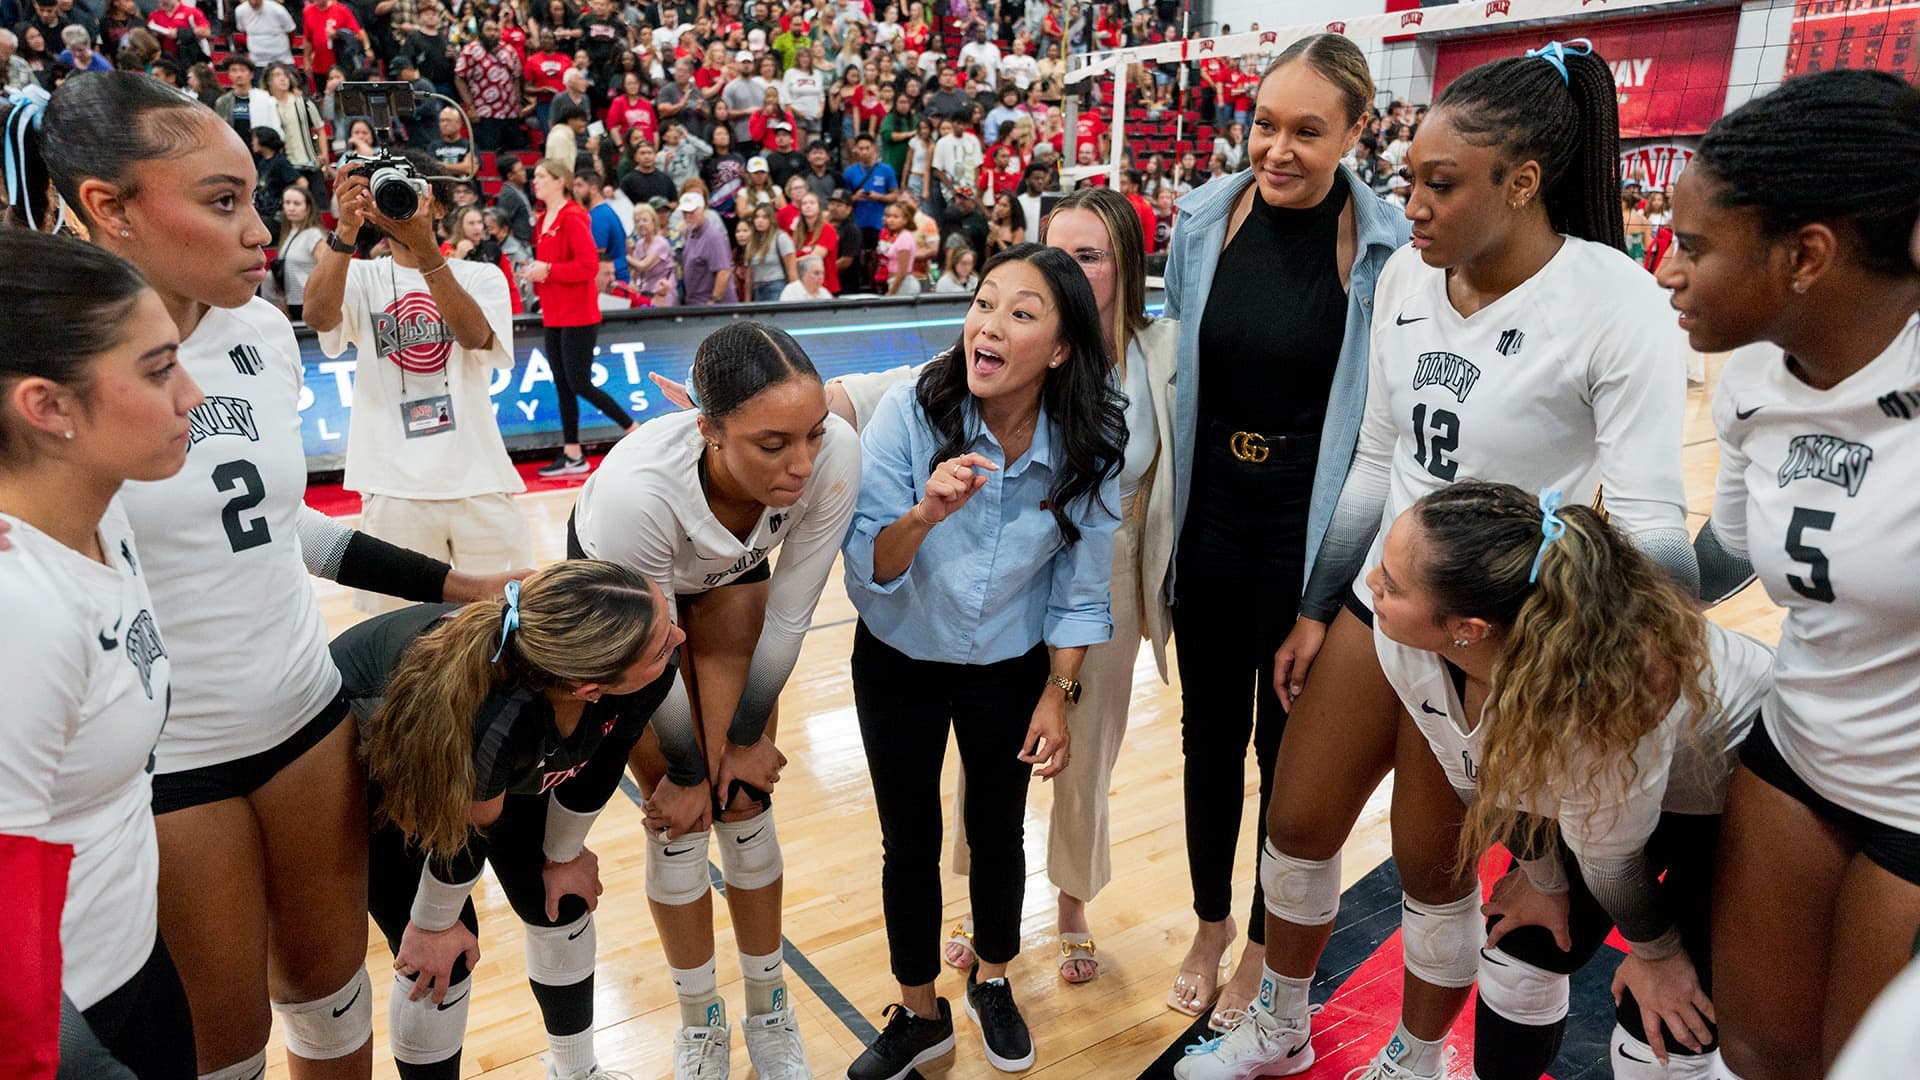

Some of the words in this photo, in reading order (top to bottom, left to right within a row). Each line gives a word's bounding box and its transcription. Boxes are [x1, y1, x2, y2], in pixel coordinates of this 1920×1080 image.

[1412, 351, 1481, 404] UNLV
[187, 395, 260, 453] NLV
[1412, 402, 1460, 483] 12
[1777, 434, 1874, 498] UNLV
[211, 458, 272, 554] 2
[1785, 506, 1836, 604] 5
